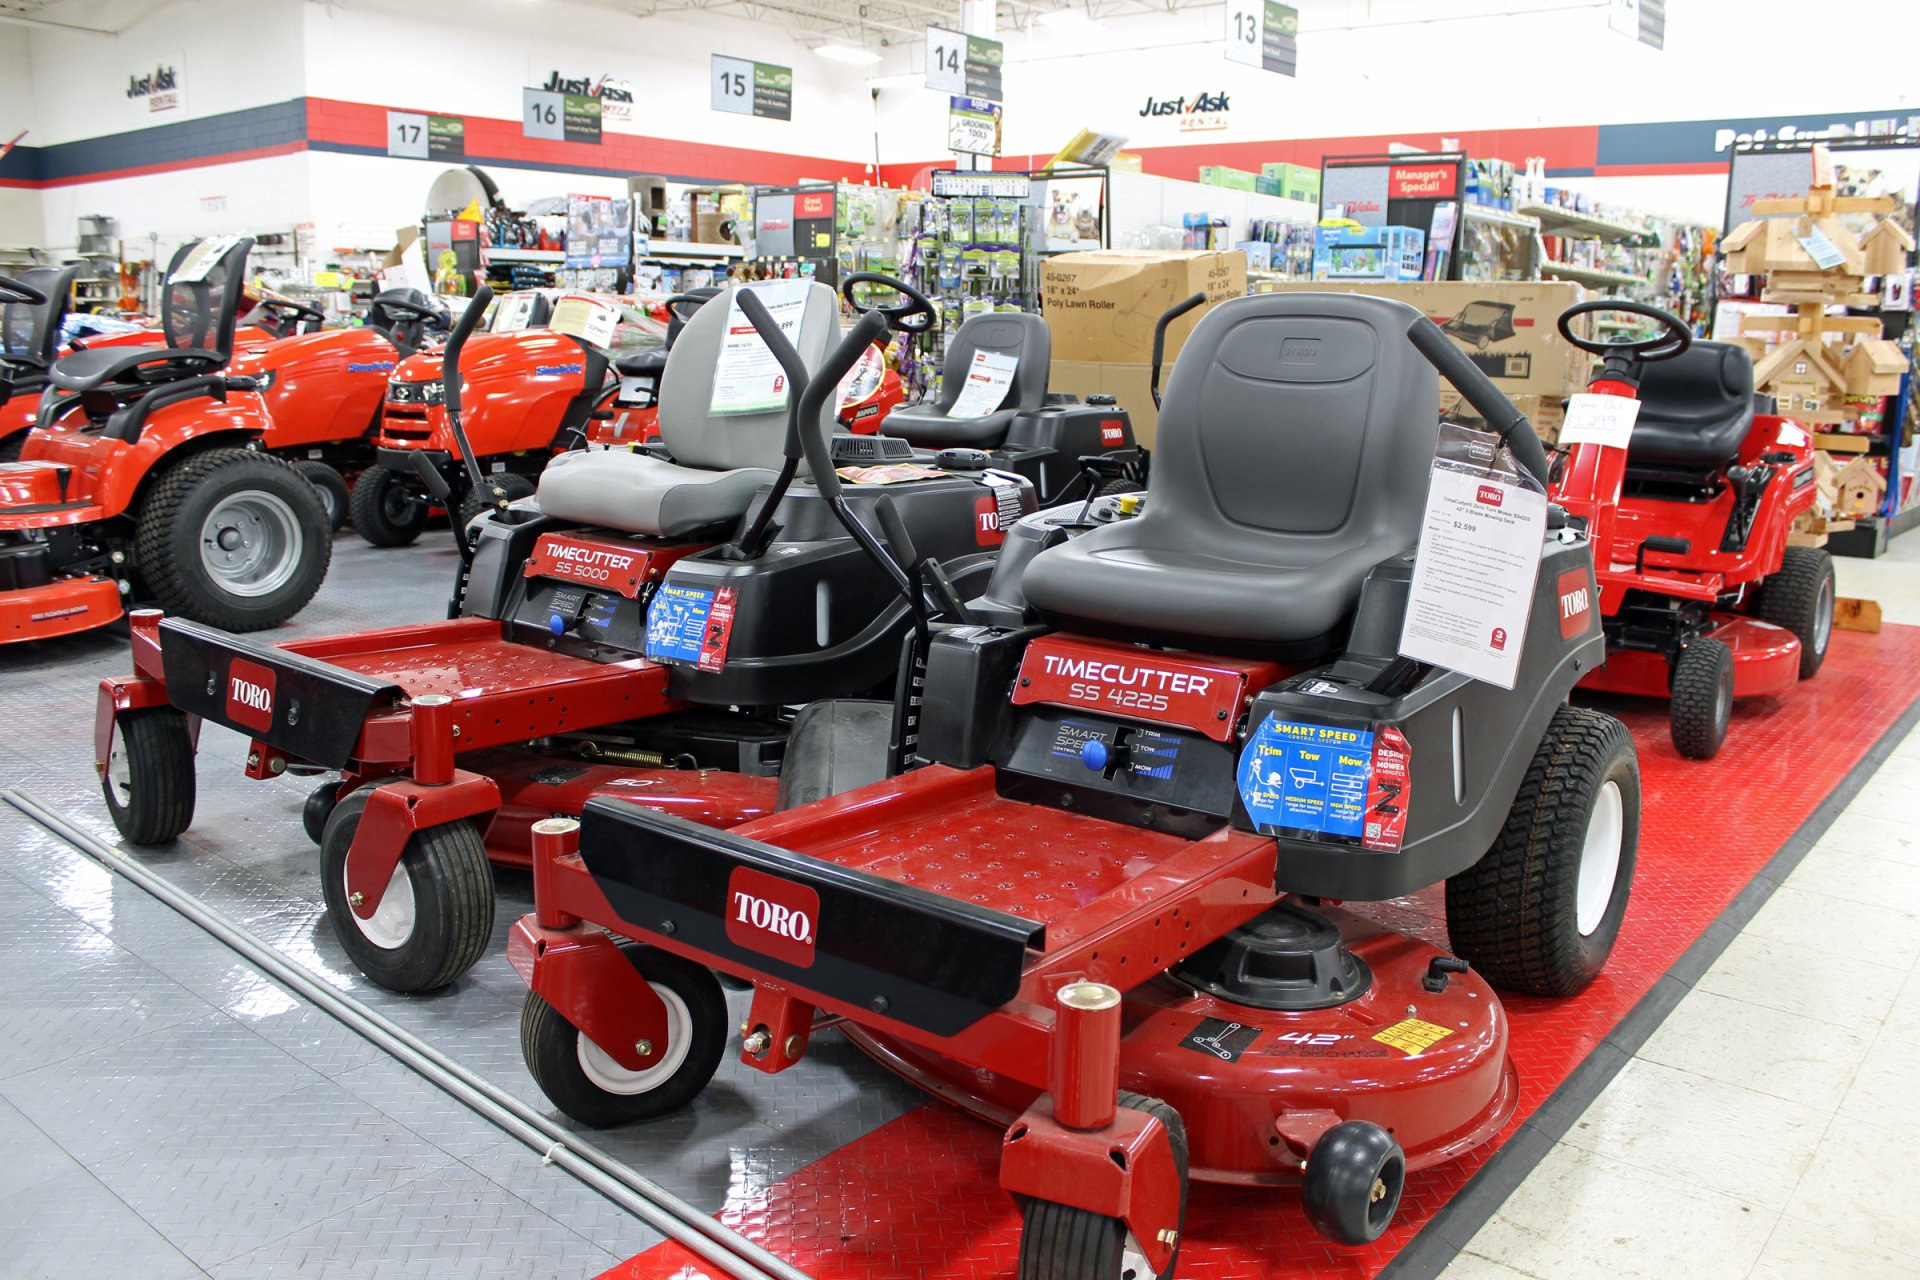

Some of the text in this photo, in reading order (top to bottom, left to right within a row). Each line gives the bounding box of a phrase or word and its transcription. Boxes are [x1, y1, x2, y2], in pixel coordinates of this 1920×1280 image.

[1234, 11, 1256, 44] 13
[935, 45, 959, 74] 14
[127, 66, 176, 98] Just Ask
[543, 70, 591, 96] Just
[720, 72, 745, 97] 15
[1139, 91, 1231, 117] Just Ask
[532, 103, 556, 125] 16
[962, 118, 993, 131] GROOMING
[1180, 117, 1228, 127] RENTAL
[397, 124, 421, 144] 17
[969, 128, 987, 139] TOOLS
[1715, 129, 1768, 152] Pet
[1395, 170, 1447, 182] Manager's
[1400, 181, 1440, 194] Special!
[1046, 273, 1077, 283] 45-0267
[1208, 267, 1231, 278] 45-0267
[1046, 286, 1058, 295] 18"
[1067, 287, 1080, 296] 24"
[1207, 282, 1217, 291] 18"
[1222, 279, 1232, 289] 24"
[1210, 289, 1242, 303] Lawn Roller
[1047, 298, 1116, 310] Poly Lawn Roller
[349, 361, 394, 373] Simplicity
[536, 364, 582, 375] Simplicity
[1102, 428, 1123, 439] TORO
[1480, 490, 1501, 502] TORO
[1497, 509, 1513, 517] Mower
[979, 512, 998, 531] TO
[1503, 517, 1515, 525] Deck
[546, 543, 632, 569] TIMECUTTER
[555, 562, 609, 580] SS 5000
[554, 592, 580, 602] SMART
[1561, 587, 1589, 619] TORO
[551, 599, 574, 609] SPEED
[1495, 630, 1503, 640] 3
[1044, 655, 1210, 696] TIMECUTTER
[232, 677, 271, 712] TORO
[1069, 683, 1169, 711] SS 4225
[1058, 725, 1108, 742] SMART
[1145, 730, 1161, 738] TRIM
[1275, 723, 1357, 742] SMART SPEED
[1383, 731, 1402, 742] TORO
[1055, 736, 1087, 749] SPE
[1288, 734, 1342, 745] CONTROL SYSTEM
[1053, 745, 1077, 754] CONTROL
[1259, 744, 1282, 756] Trim
[1299, 750, 1320, 761] Tow
[1377, 748, 1404, 759] DESIGN
[1339, 756, 1363, 767] Mow
[1376, 761, 1405, 772] MOWER
[734, 891, 811, 943] TORO
[1277, 1032, 1355, 1045] 42"
[1300, 1050, 1388, 1058] DISCHARGE
